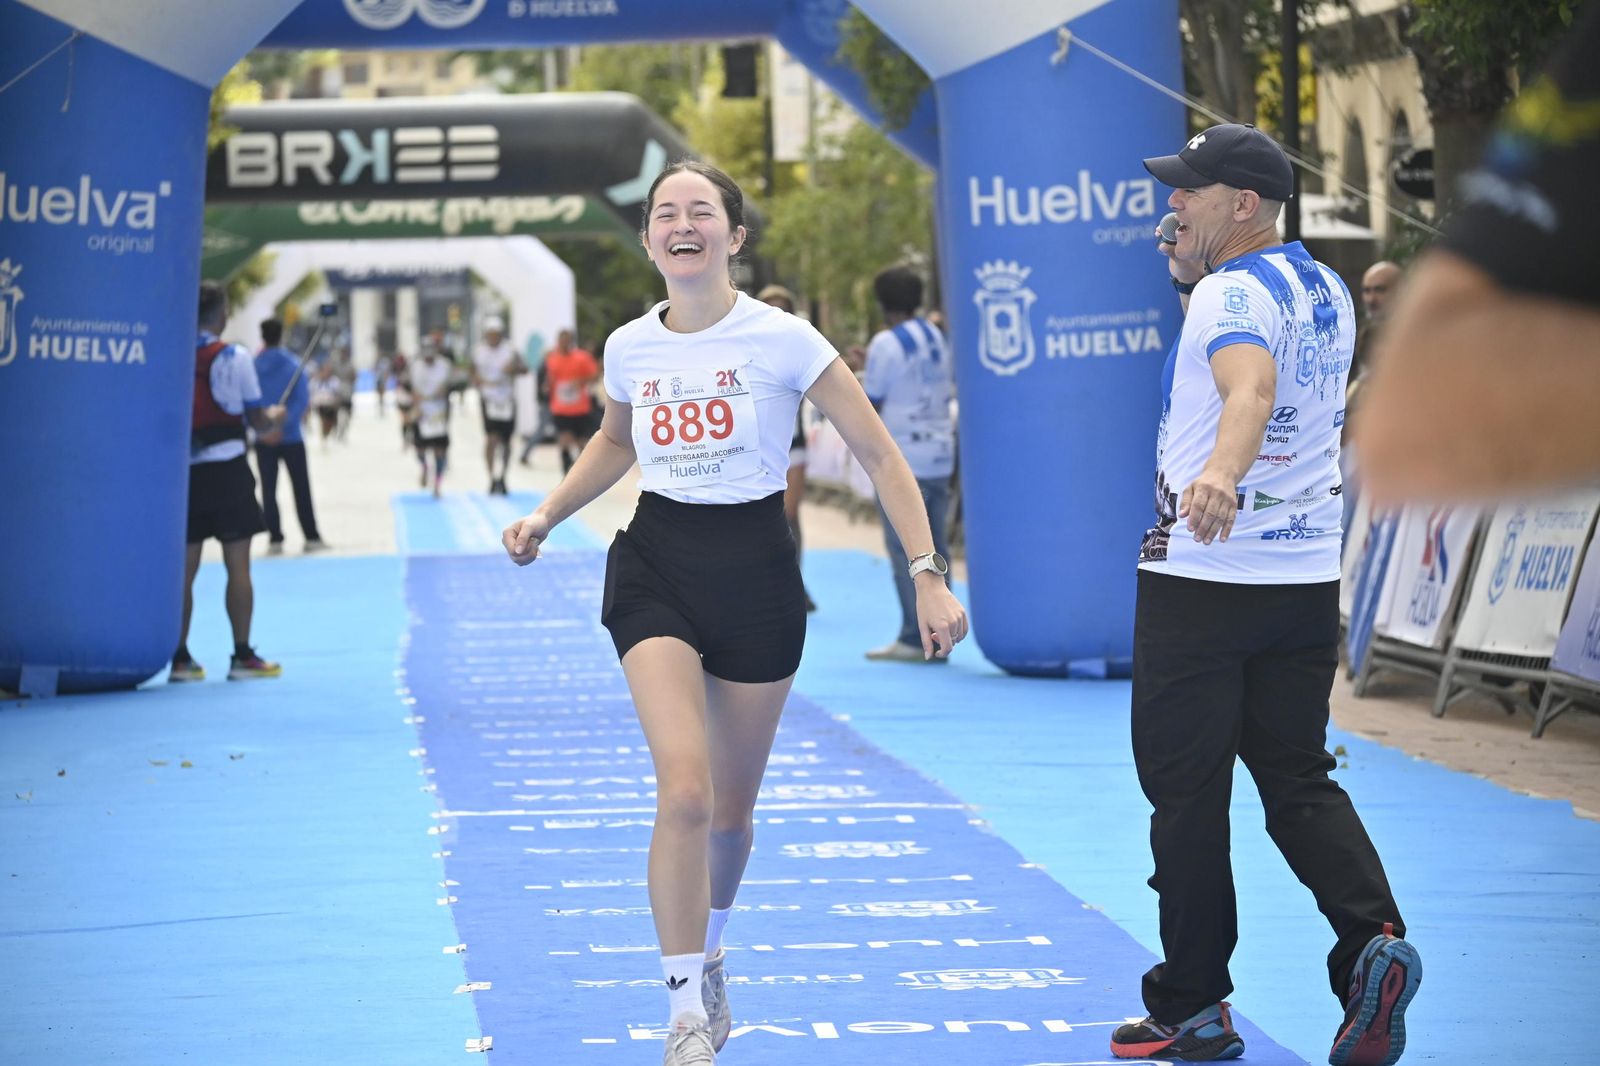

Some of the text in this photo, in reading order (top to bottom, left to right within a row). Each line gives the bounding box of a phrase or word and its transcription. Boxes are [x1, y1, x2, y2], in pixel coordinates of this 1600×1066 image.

[968, 168, 1156, 227] Huelva
[87, 234, 154, 256] original
[31, 315, 149, 336] Ayuntamiento de
[1045, 311, 1143, 331] Ayuntamiento
[28, 334, 146, 365] HUELVA
[1045, 326, 1162, 359] HUELVA
[651, 398, 734, 446] 889
[1265, 424, 1299, 434] YUNDAI
[651, 446, 745, 464] LOPEZ ESTERGAARD JACOBSEN
[669, 460, 722, 479] Huelva
[1514, 545, 1574, 592] HUELVA
